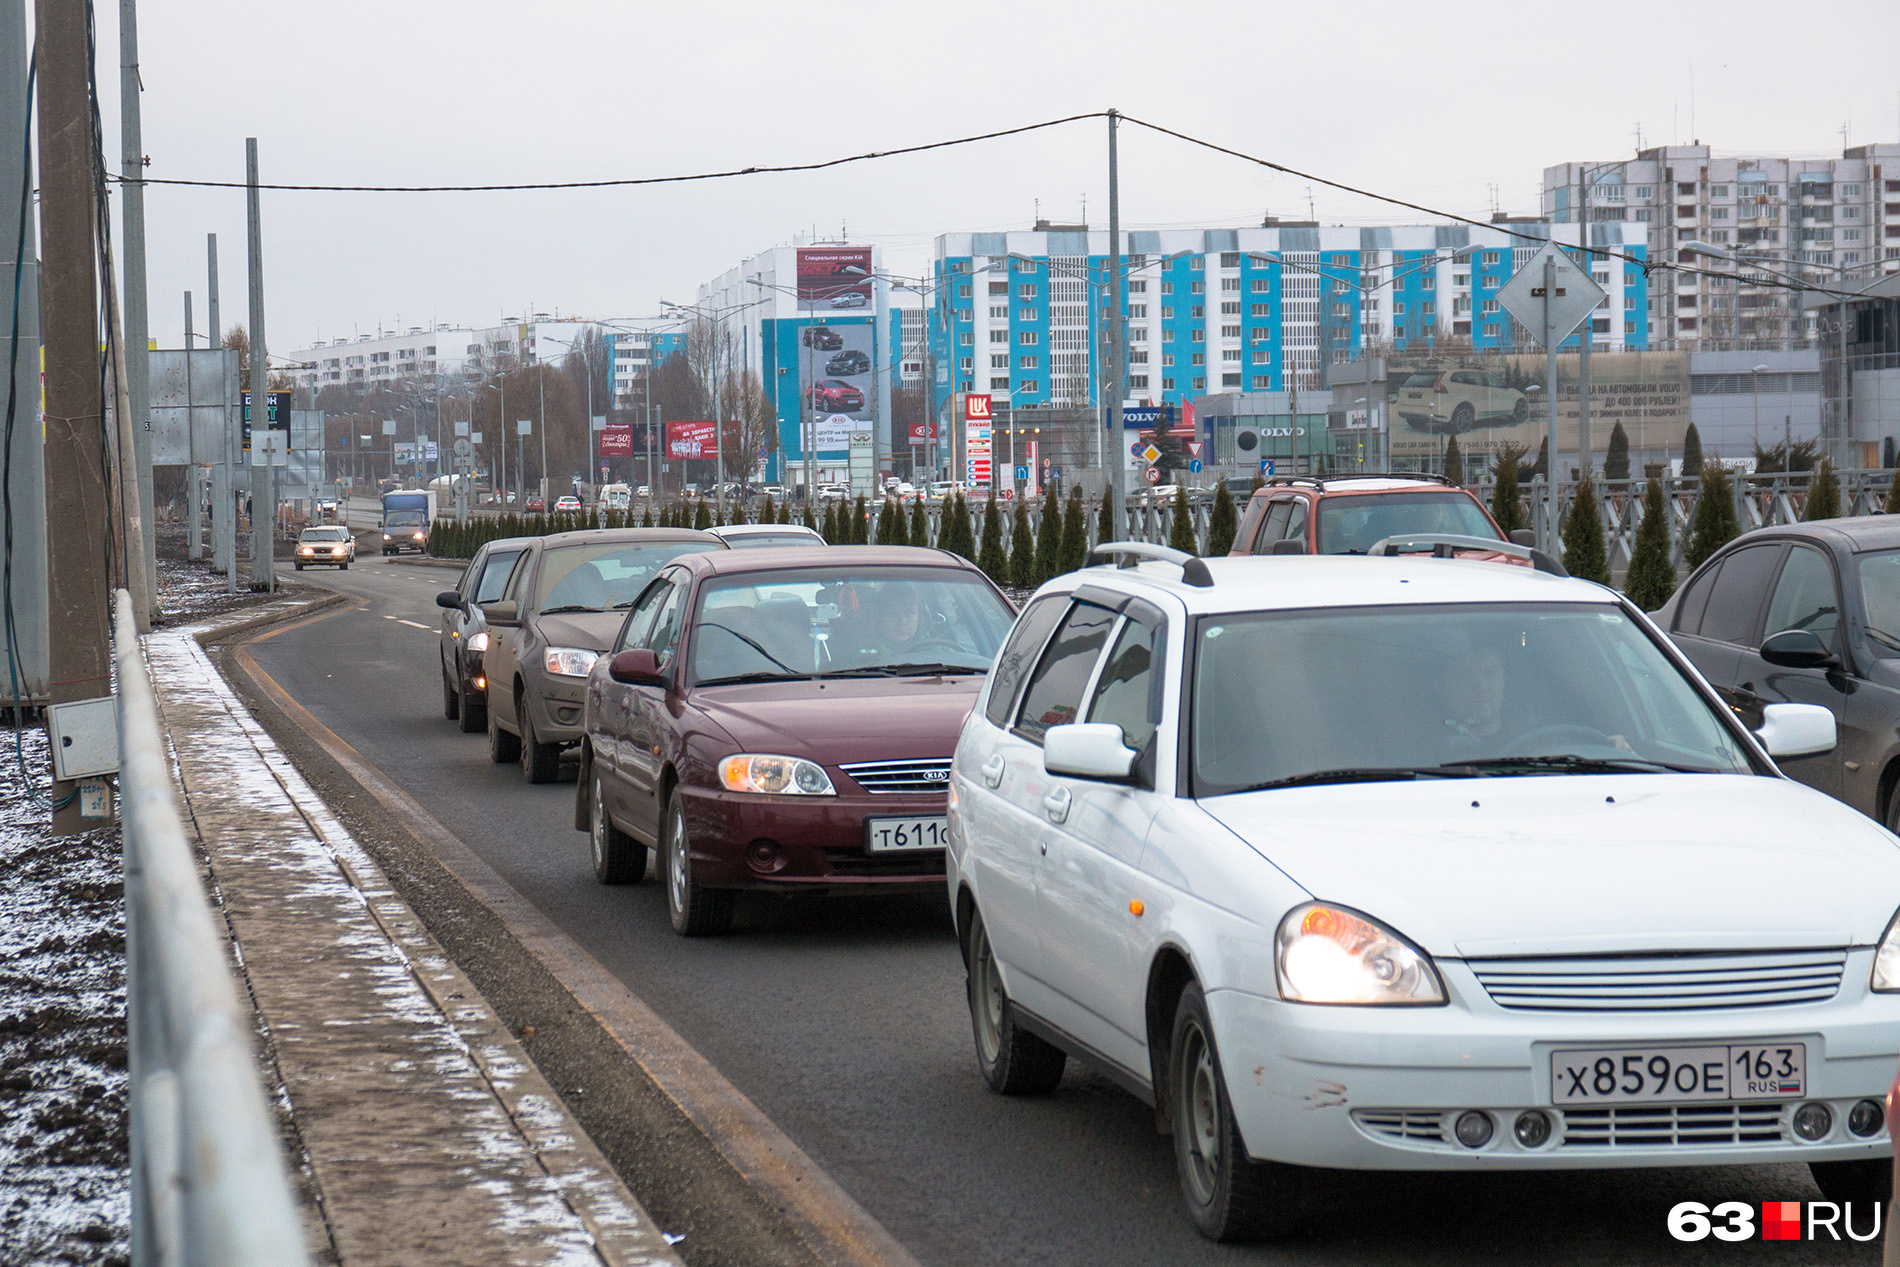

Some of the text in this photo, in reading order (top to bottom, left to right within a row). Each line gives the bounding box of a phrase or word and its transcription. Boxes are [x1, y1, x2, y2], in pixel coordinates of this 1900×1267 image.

[1598, 384, 1608, 394] НА
[1609, 383, 1657, 394] АВТОМОБИЛИ
[1659, 382, 1681, 393] VOLVO
[1605, 396, 1616, 408] ДО
[1617, 396, 1631, 406] 400
[1633, 396, 1648, 406] 000
[1599, 409, 1624, 418] ЗИМНИХ
[1567, 1048, 1794, 1096] Х859ОЕ 163
[1748, 1080, 1777, 1094] RUS
